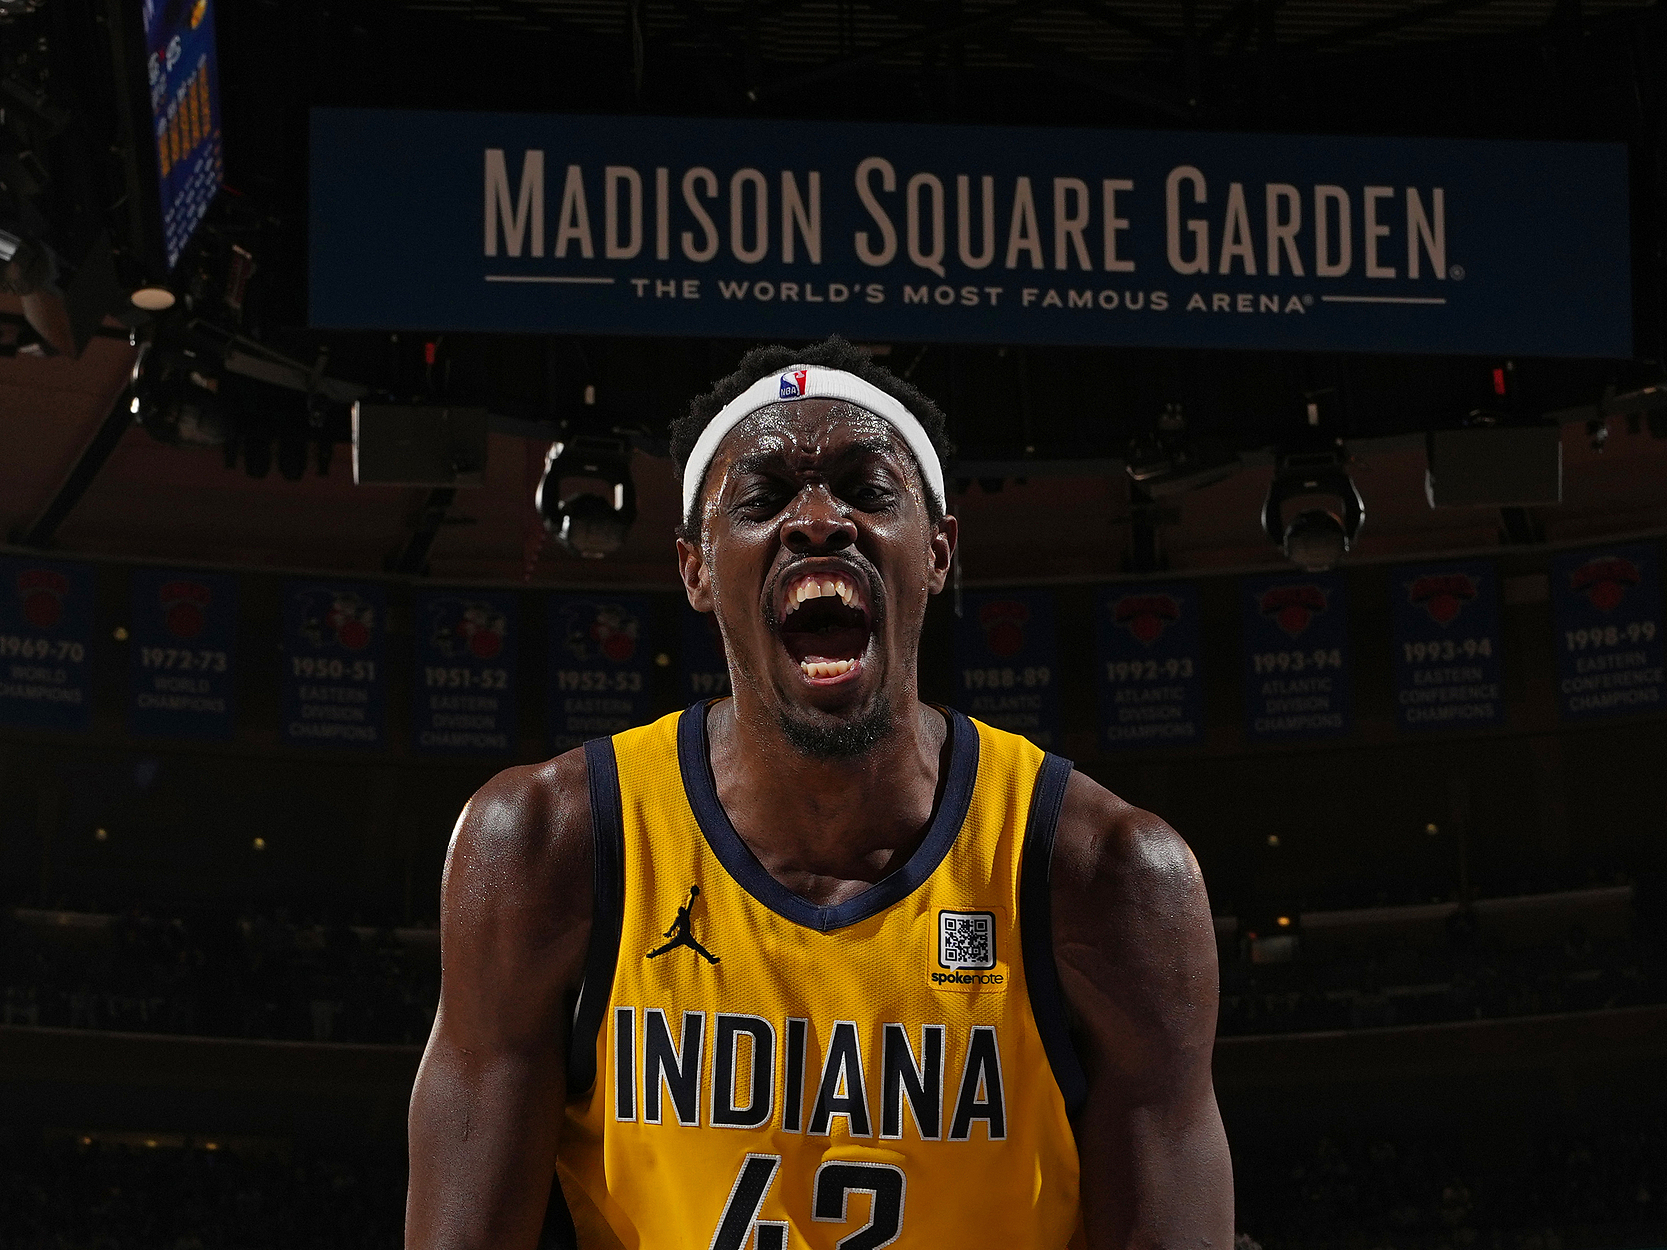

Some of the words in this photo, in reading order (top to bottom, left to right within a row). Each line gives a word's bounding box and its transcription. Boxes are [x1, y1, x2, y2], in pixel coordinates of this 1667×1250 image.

[484, 148, 821, 264] MADISON
[854, 156, 1136, 277] SQUARE
[631, 279, 701, 299] THE
[718, 281, 886, 304] WORLD'S
[903, 286, 1004, 308] MOST
[1022, 289, 1170, 312] FAMOUS
[780, 386, 797, 396] NBA
[931, 971, 1004, 985] spokenote
[614, 1006, 1007, 1141] INDIANA
